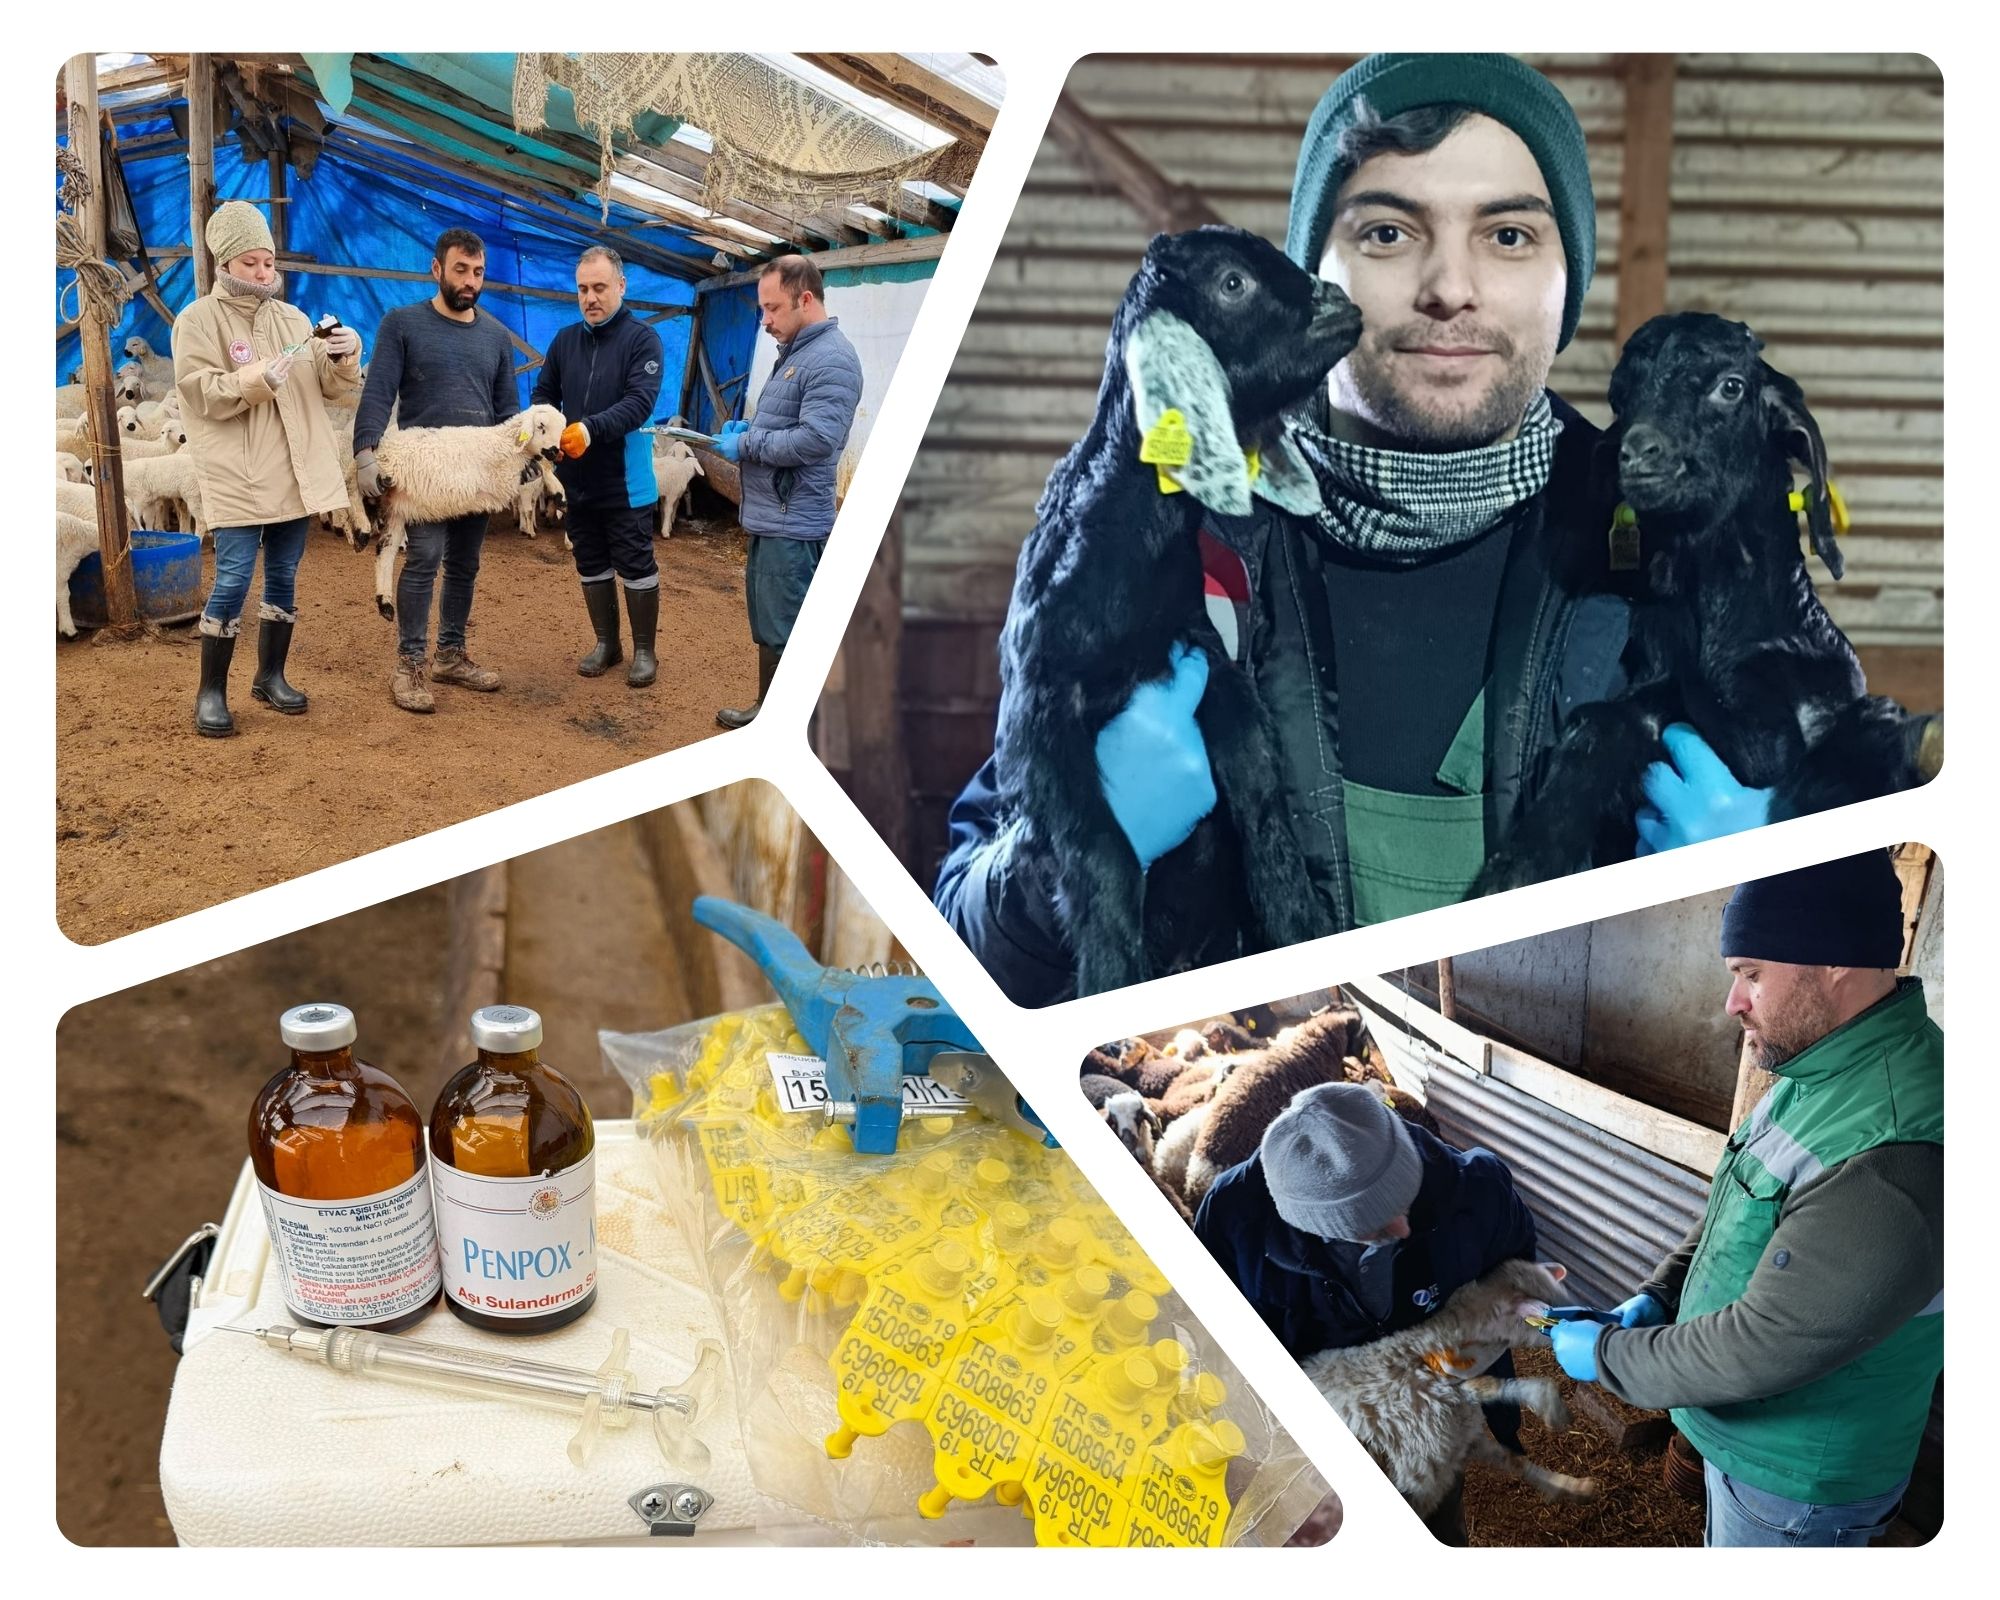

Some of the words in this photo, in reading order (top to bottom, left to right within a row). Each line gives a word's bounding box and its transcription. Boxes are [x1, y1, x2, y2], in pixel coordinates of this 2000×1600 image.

[393, 1203, 405, 1212] 100
[463, 1237, 572, 1281] PENPOX
[458, 1286, 481, 1306] Aşı
[485, 1284, 583, 1310] Sulandırma
[880, 1284, 906, 1314] TR
[934, 1318, 957, 1341] 19
[863, 1305, 945, 1369] 1508963
[972, 1336, 997, 1368] TR
[1025, 1371, 1047, 1396] 19
[841, 1338, 926, 1405] 1508963
[842, 1372, 864, 1396] 19
[871, 1388, 899, 1419] TR
[956, 1358, 1037, 1426] 1508963
[936, 1393, 1020, 1465] 1508963
[939, 1431, 961, 1457] 19
[969, 1447, 995, 1481] TR
[1051, 1415, 1127, 1489] 1508964
[1063, 1392, 1088, 1425] TR
[1114, 1431, 1136, 1457] 19
[1033, 1452, 1113, 1530] 1508964
[1038, 1493, 1059, 1520] 19
[1067, 1511, 1092, 1546] TR
[1141, 1477, 1211, 1547] 1508964
[1151, 1454, 1174, 1488] TR
[1200, 1495, 1219, 1521] 19
